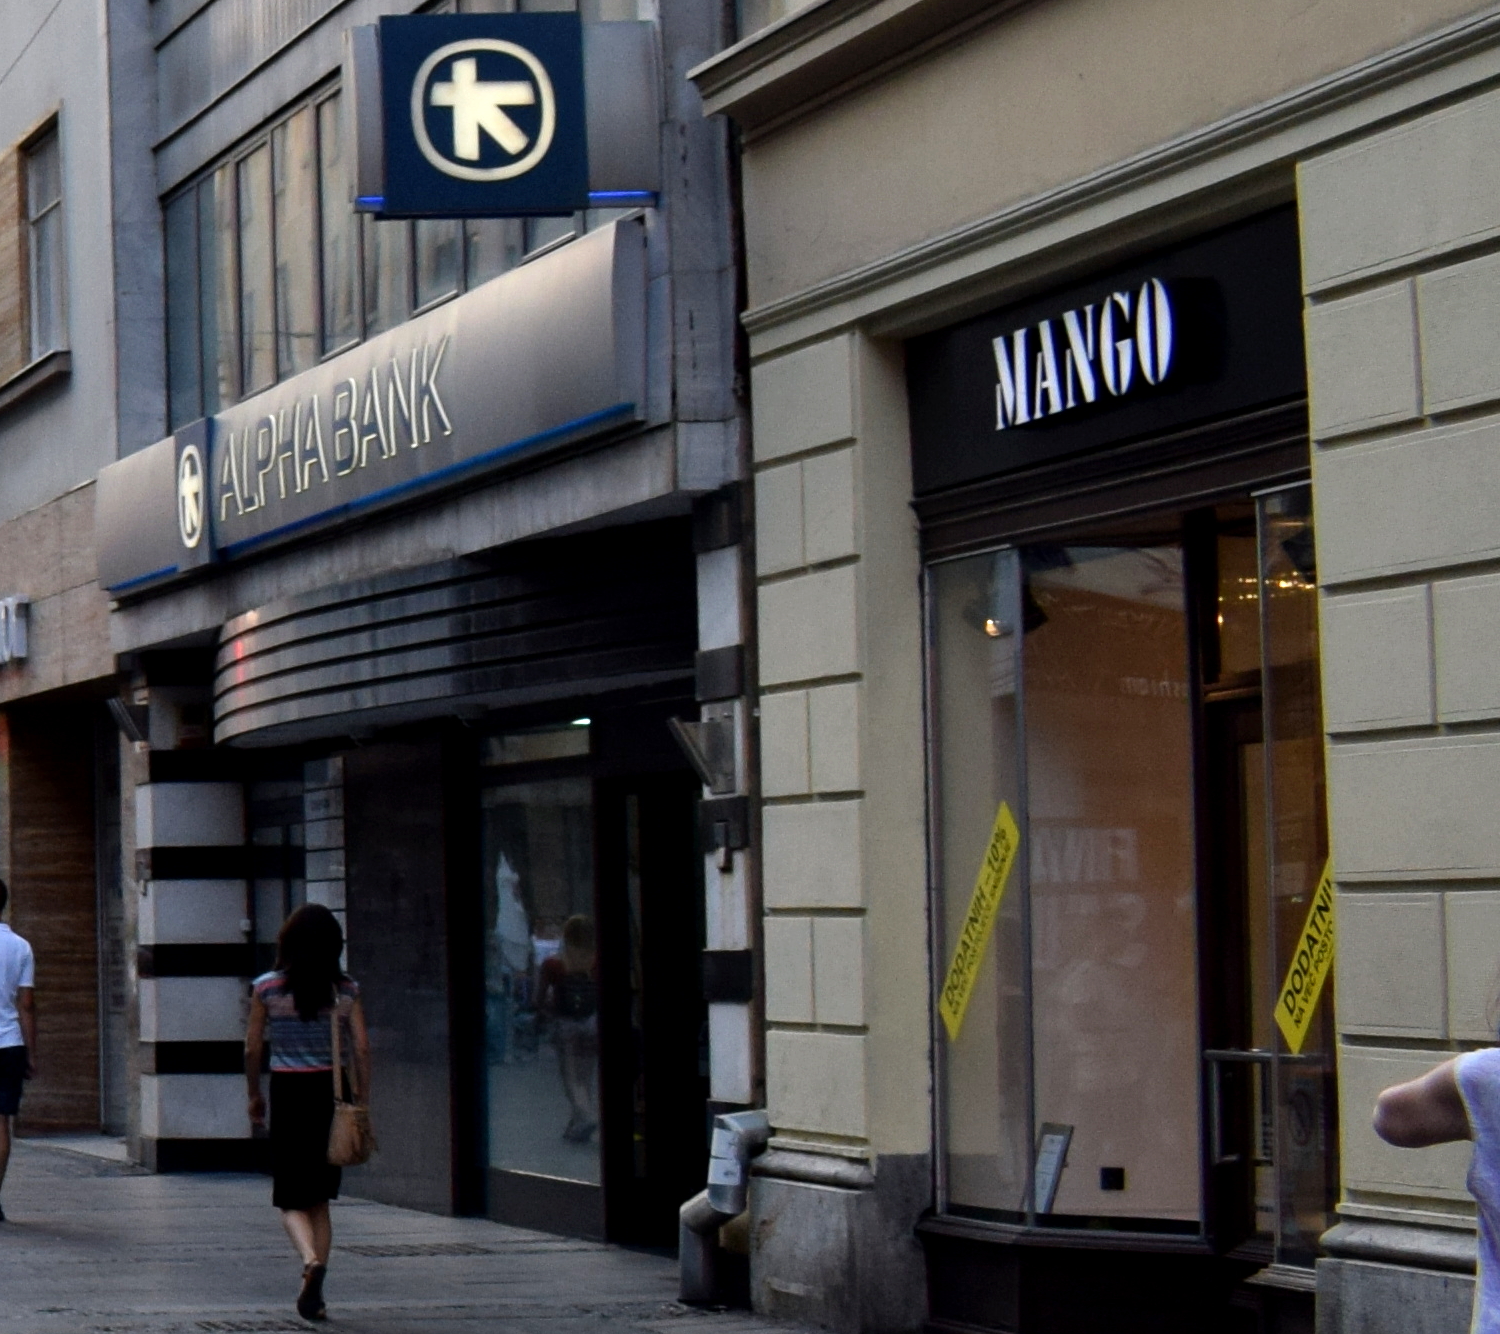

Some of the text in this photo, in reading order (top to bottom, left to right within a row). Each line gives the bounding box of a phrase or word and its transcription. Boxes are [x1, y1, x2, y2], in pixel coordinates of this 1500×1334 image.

[219, 335, 452, 523] ALPHA BANK
[992, 277, 1176, 430] MANGO
